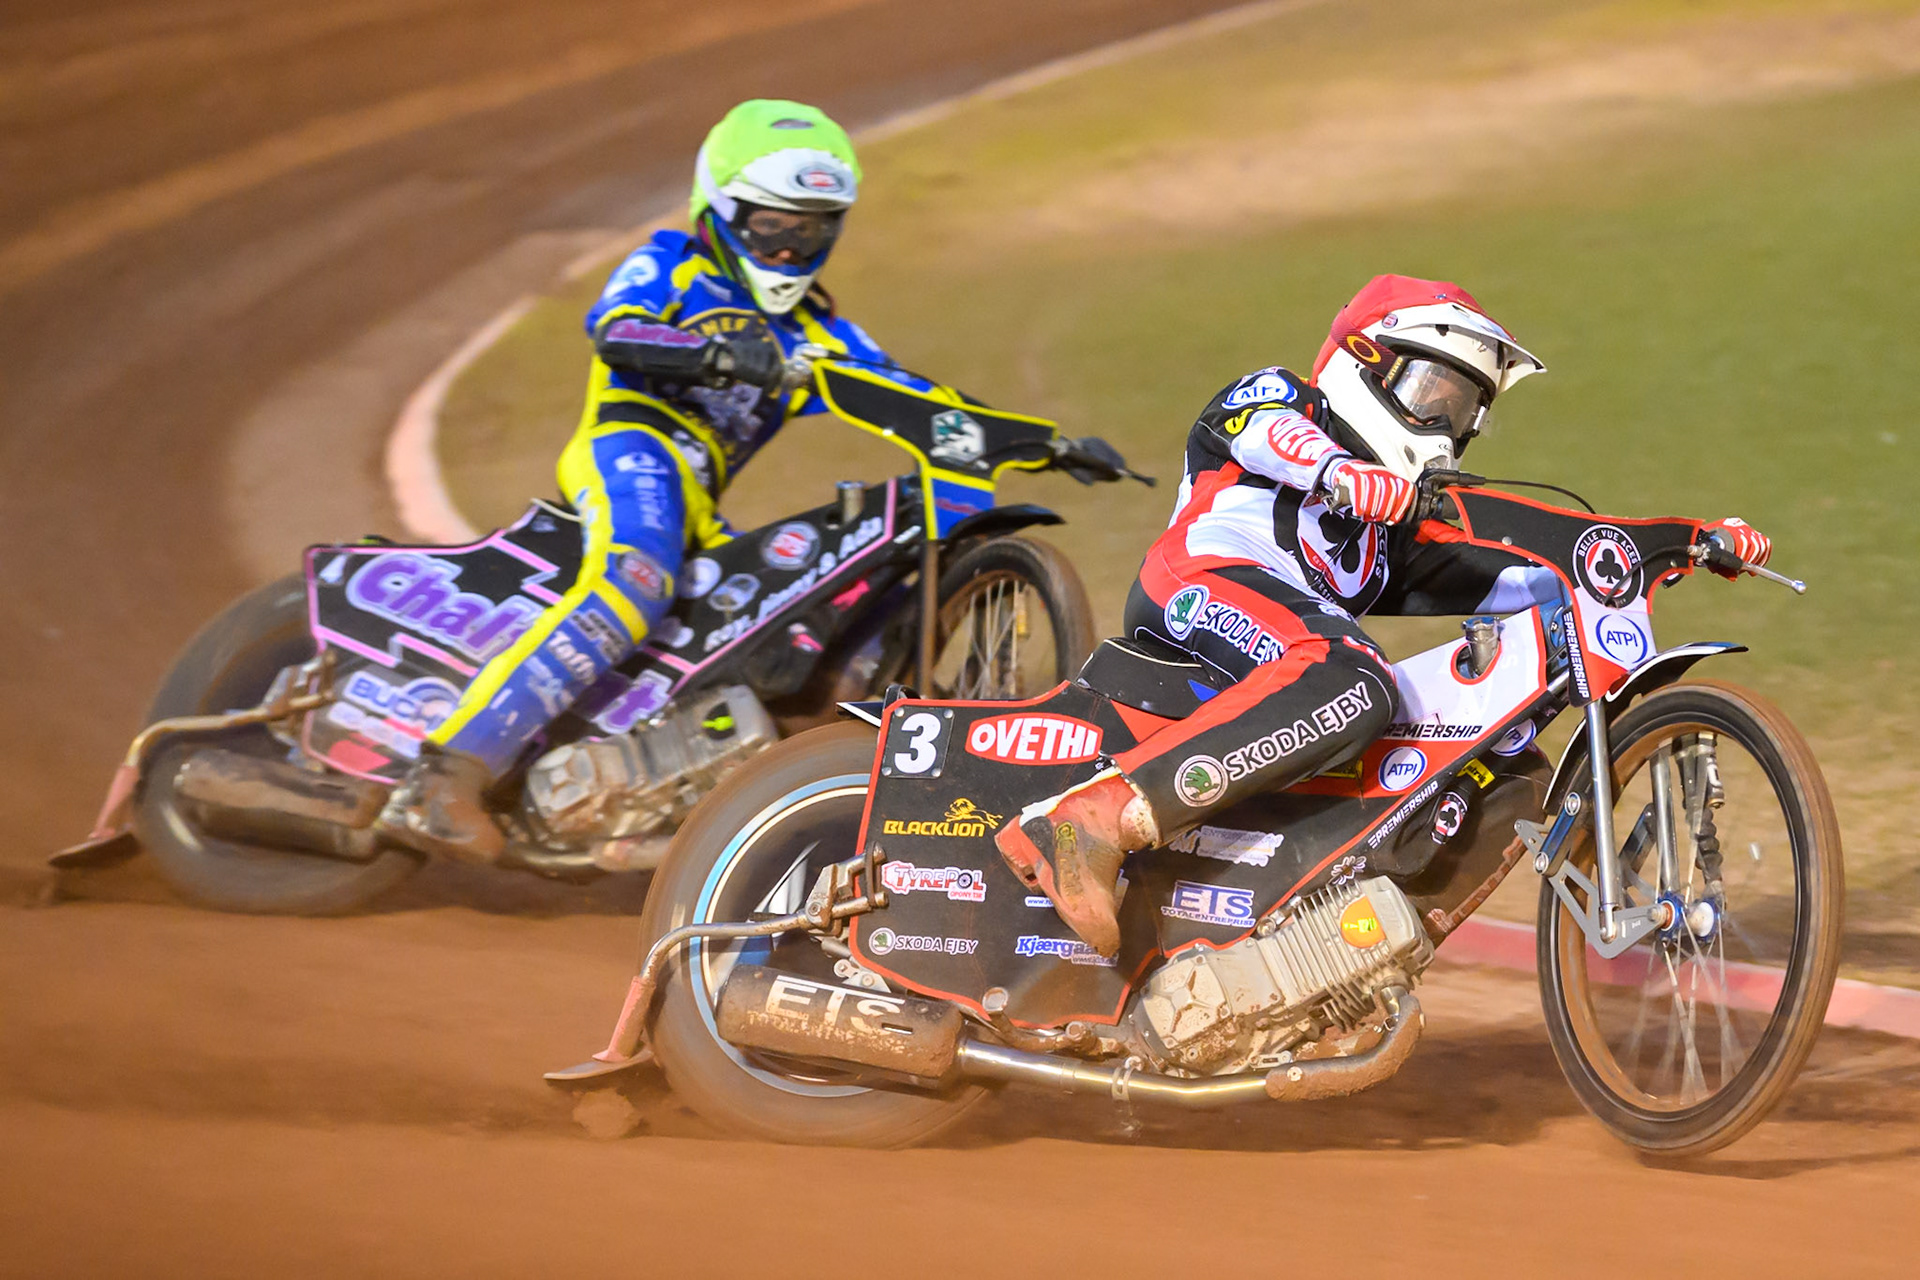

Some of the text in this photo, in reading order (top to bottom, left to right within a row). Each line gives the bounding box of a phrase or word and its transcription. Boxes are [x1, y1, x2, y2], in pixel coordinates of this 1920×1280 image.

[1578, 530, 1638, 564] BELLE VUE ACES
[1201, 604, 1253, 652] SKODA
[1606, 630, 1638, 648] ATPI
[1563, 612, 1590, 699] PREMIERSHIP
[894, 712, 941, 774] 3
[971, 717, 1099, 761] OVETHI
[1225, 683, 1372, 779] SKODA EJBY
[1381, 724, 1482, 739] REMIERSHIP
[1386, 762, 1418, 776] ATPI
[883, 820, 985, 838] BLACKLION
[1369, 781, 1439, 848] PREMIERSHIP
[1174, 883, 1252, 918] ETS
[896, 936, 978, 953] SKODA EJBY
[766, 975, 905, 1036] ETS
